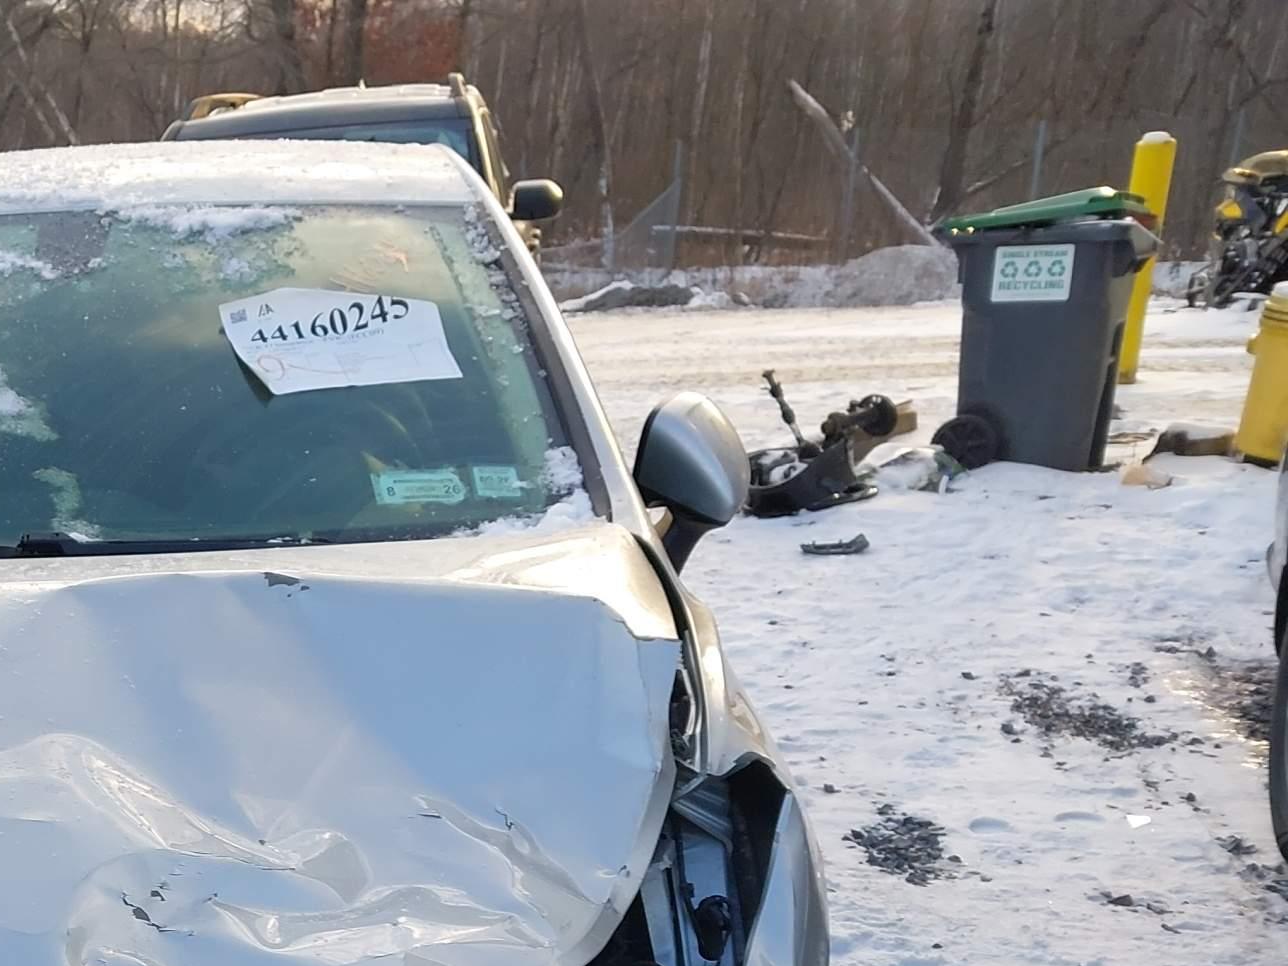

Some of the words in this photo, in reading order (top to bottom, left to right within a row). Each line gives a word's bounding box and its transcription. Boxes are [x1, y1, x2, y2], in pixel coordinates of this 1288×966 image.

[998, 280, 1064, 290] RECYCLING
[250, 295, 410, 344] 44160245
[385, 486, 396, 497] 8
[443, 484, 461, 495] 26
